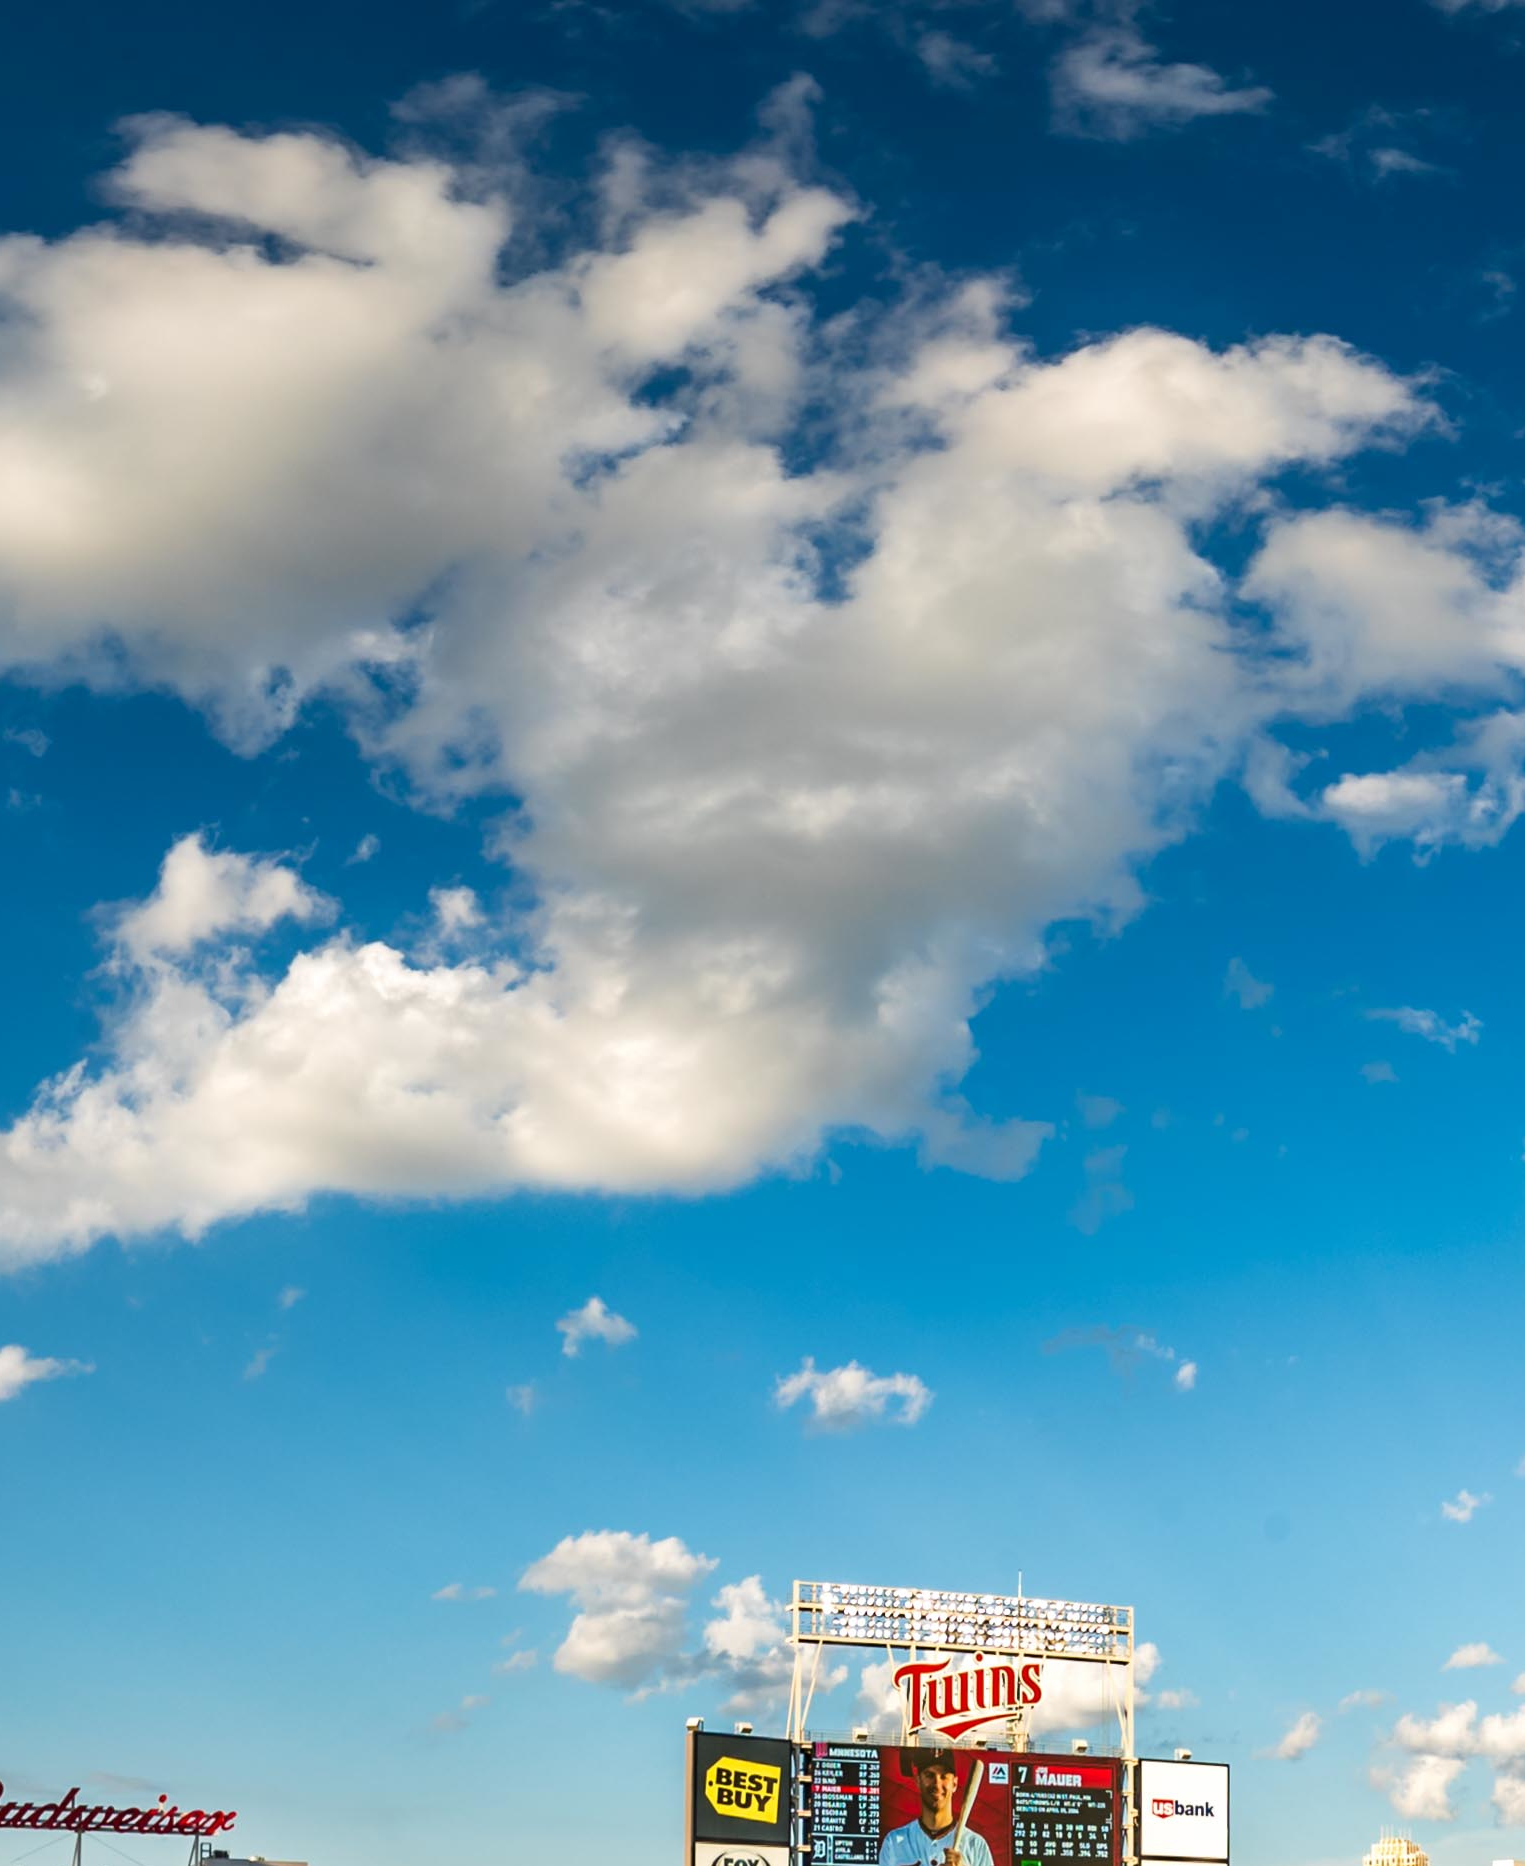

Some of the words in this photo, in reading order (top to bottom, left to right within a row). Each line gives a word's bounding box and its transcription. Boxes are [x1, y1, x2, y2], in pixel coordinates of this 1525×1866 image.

[894, 1653, 1042, 1732] Twins
[829, 1748, 878, 1759] MINNESOTA
[716, 1767, 778, 1796] BEST
[1018, 1766, 1027, 1783] 7
[1035, 1774, 1082, 1787] MAUER
[717, 1787, 772, 1813] BUY
